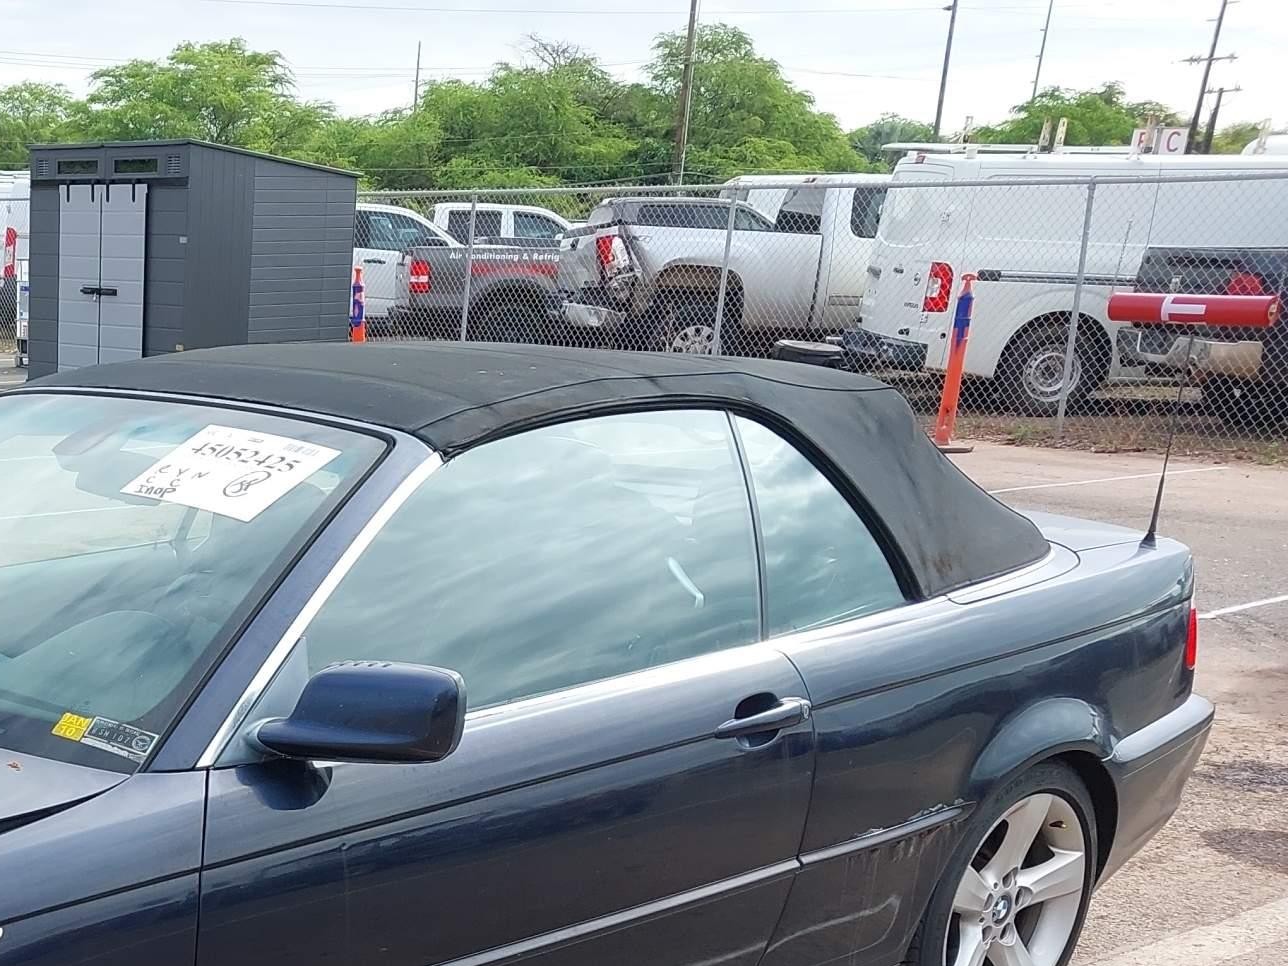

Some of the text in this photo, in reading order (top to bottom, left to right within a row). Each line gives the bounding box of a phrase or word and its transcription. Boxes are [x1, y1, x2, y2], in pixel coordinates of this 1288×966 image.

[1166, 131, 1181, 152] C
[449, 252, 463, 260] Air
[192, 442, 301, 472] 45052425
[61, 715, 87, 728] JAN
